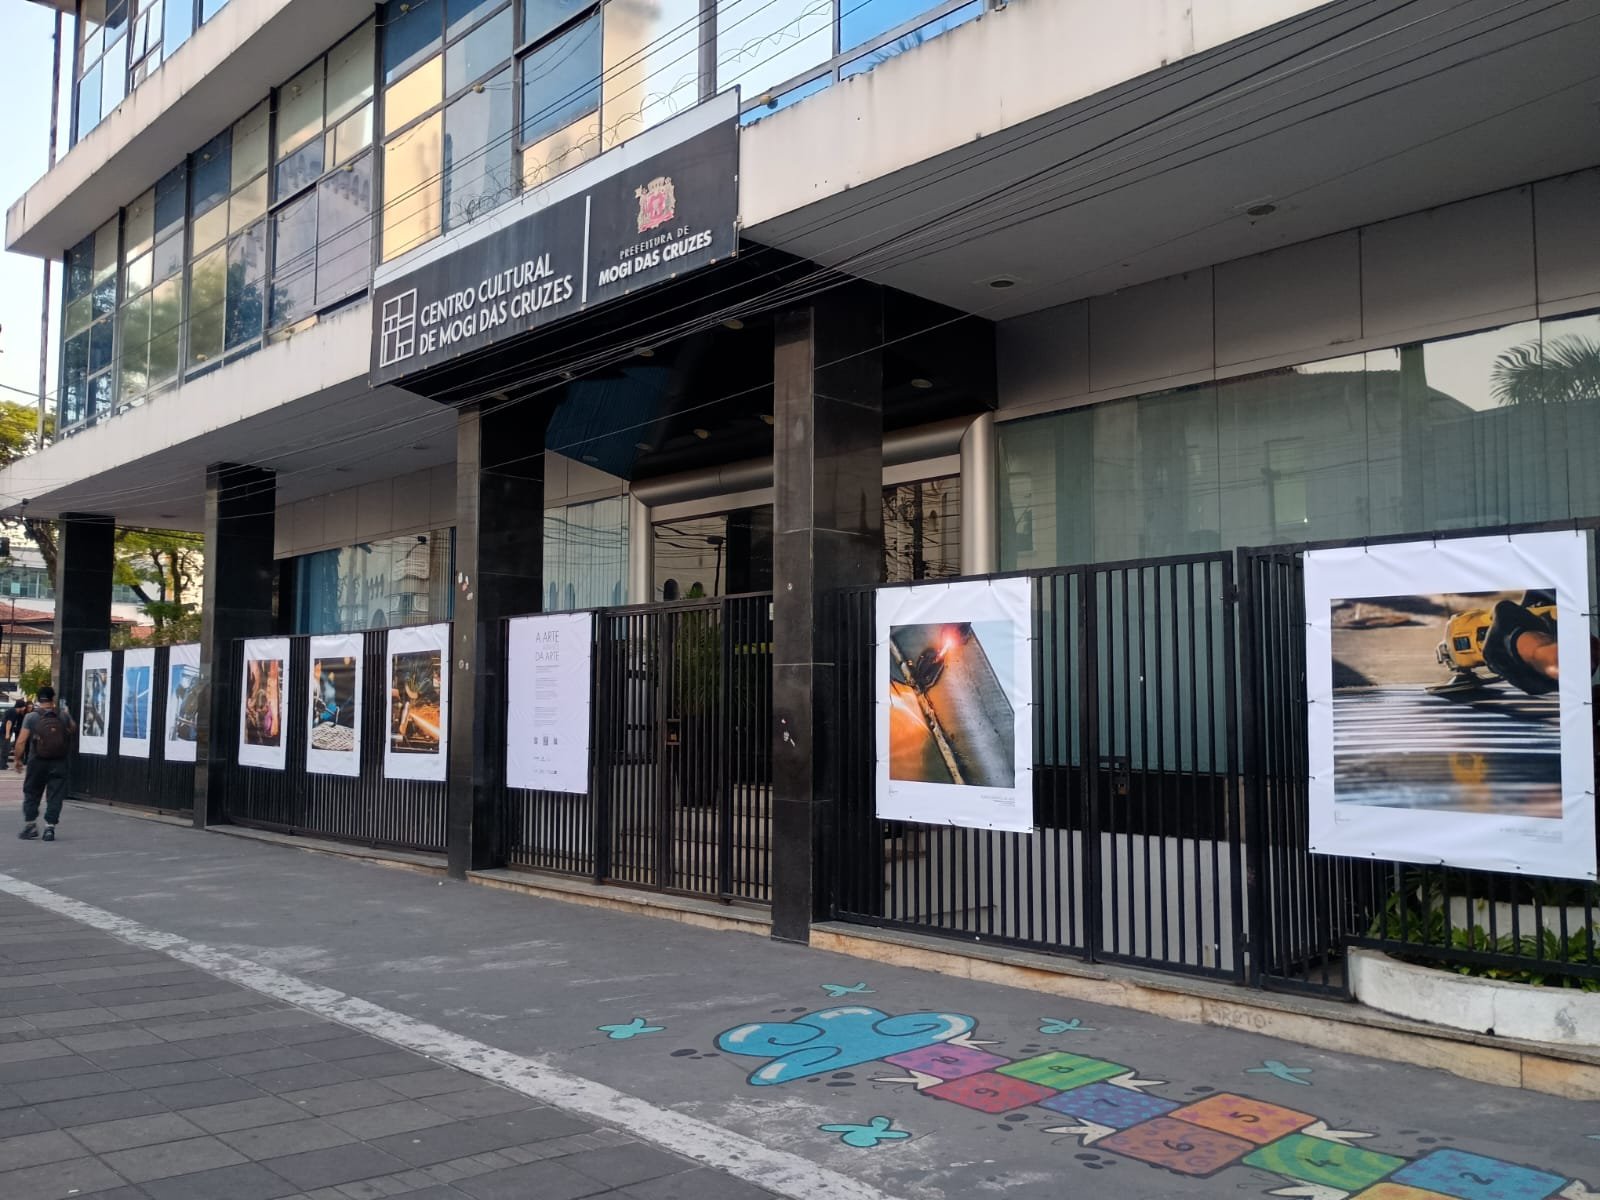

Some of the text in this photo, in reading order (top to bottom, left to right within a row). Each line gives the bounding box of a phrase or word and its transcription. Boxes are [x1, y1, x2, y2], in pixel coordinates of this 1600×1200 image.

[619, 225, 690, 260] PREFEITURA DE
[598, 229, 713, 287] MOGI DAS CRUZES
[420, 252, 554, 327] CENTRO CULTURAL
[419, 274, 573, 356] DE MOGI DAS CRUZES
[542, 630, 560, 643] ARTE
[535, 650, 560, 662] DA ARTE
[1048, 1064, 1075, 1074] 8
[974, 1087, 1000, 1098] 9
[1093, 1097, 1121, 1108] 7
[1229, 1111, 1261, 1123] 5
[1163, 1139, 1196, 1152] 6
[1458, 1171, 1494, 1185] 2
